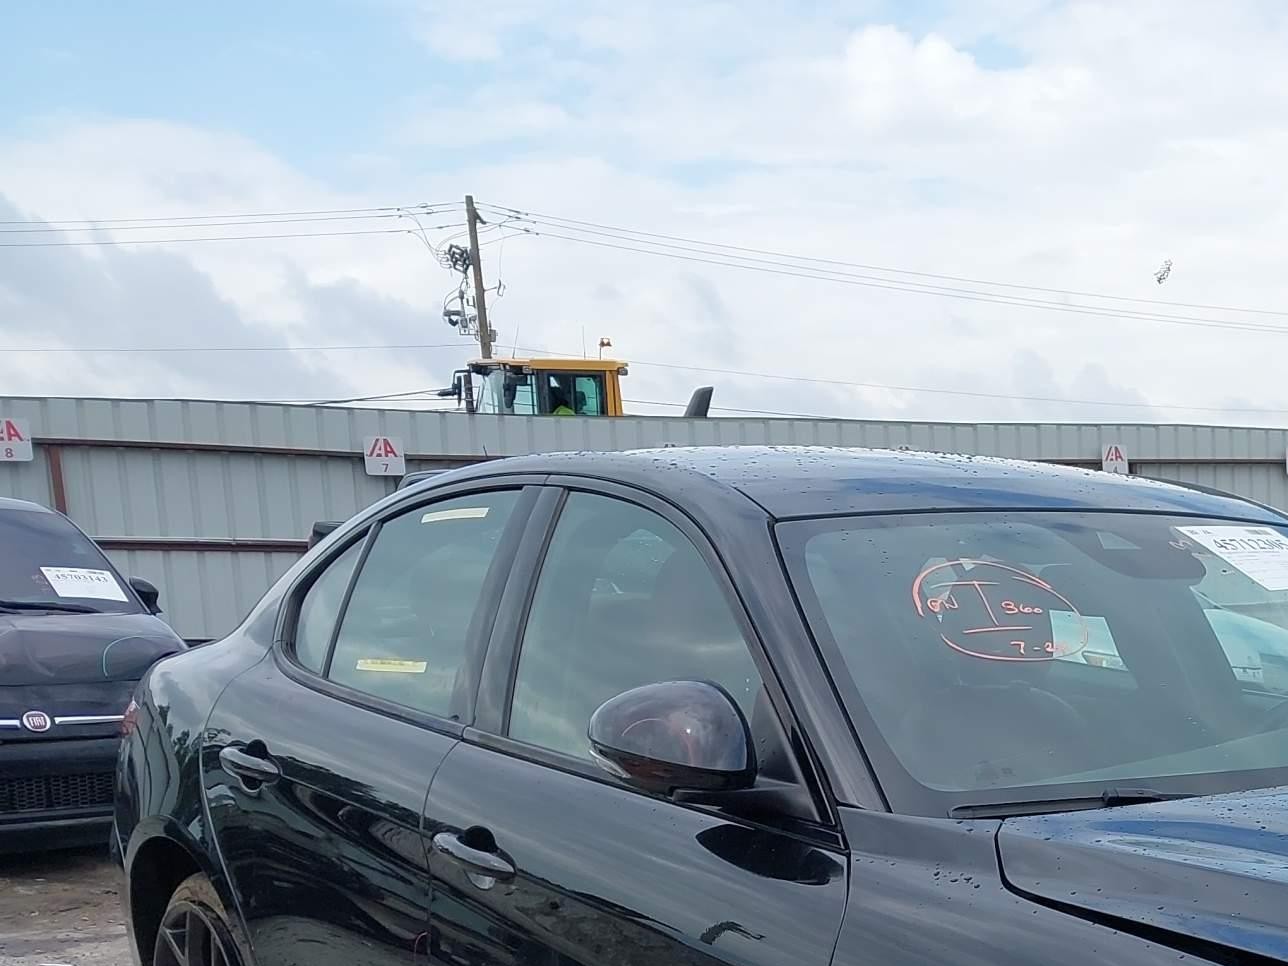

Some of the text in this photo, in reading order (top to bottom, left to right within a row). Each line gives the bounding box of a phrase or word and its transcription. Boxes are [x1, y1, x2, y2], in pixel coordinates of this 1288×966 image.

[5, 448, 14, 458] 8
[381, 463, 389, 472] 7
[1001, 600, 1043, 614] 360
[29, 717, 46, 727] FIAT
